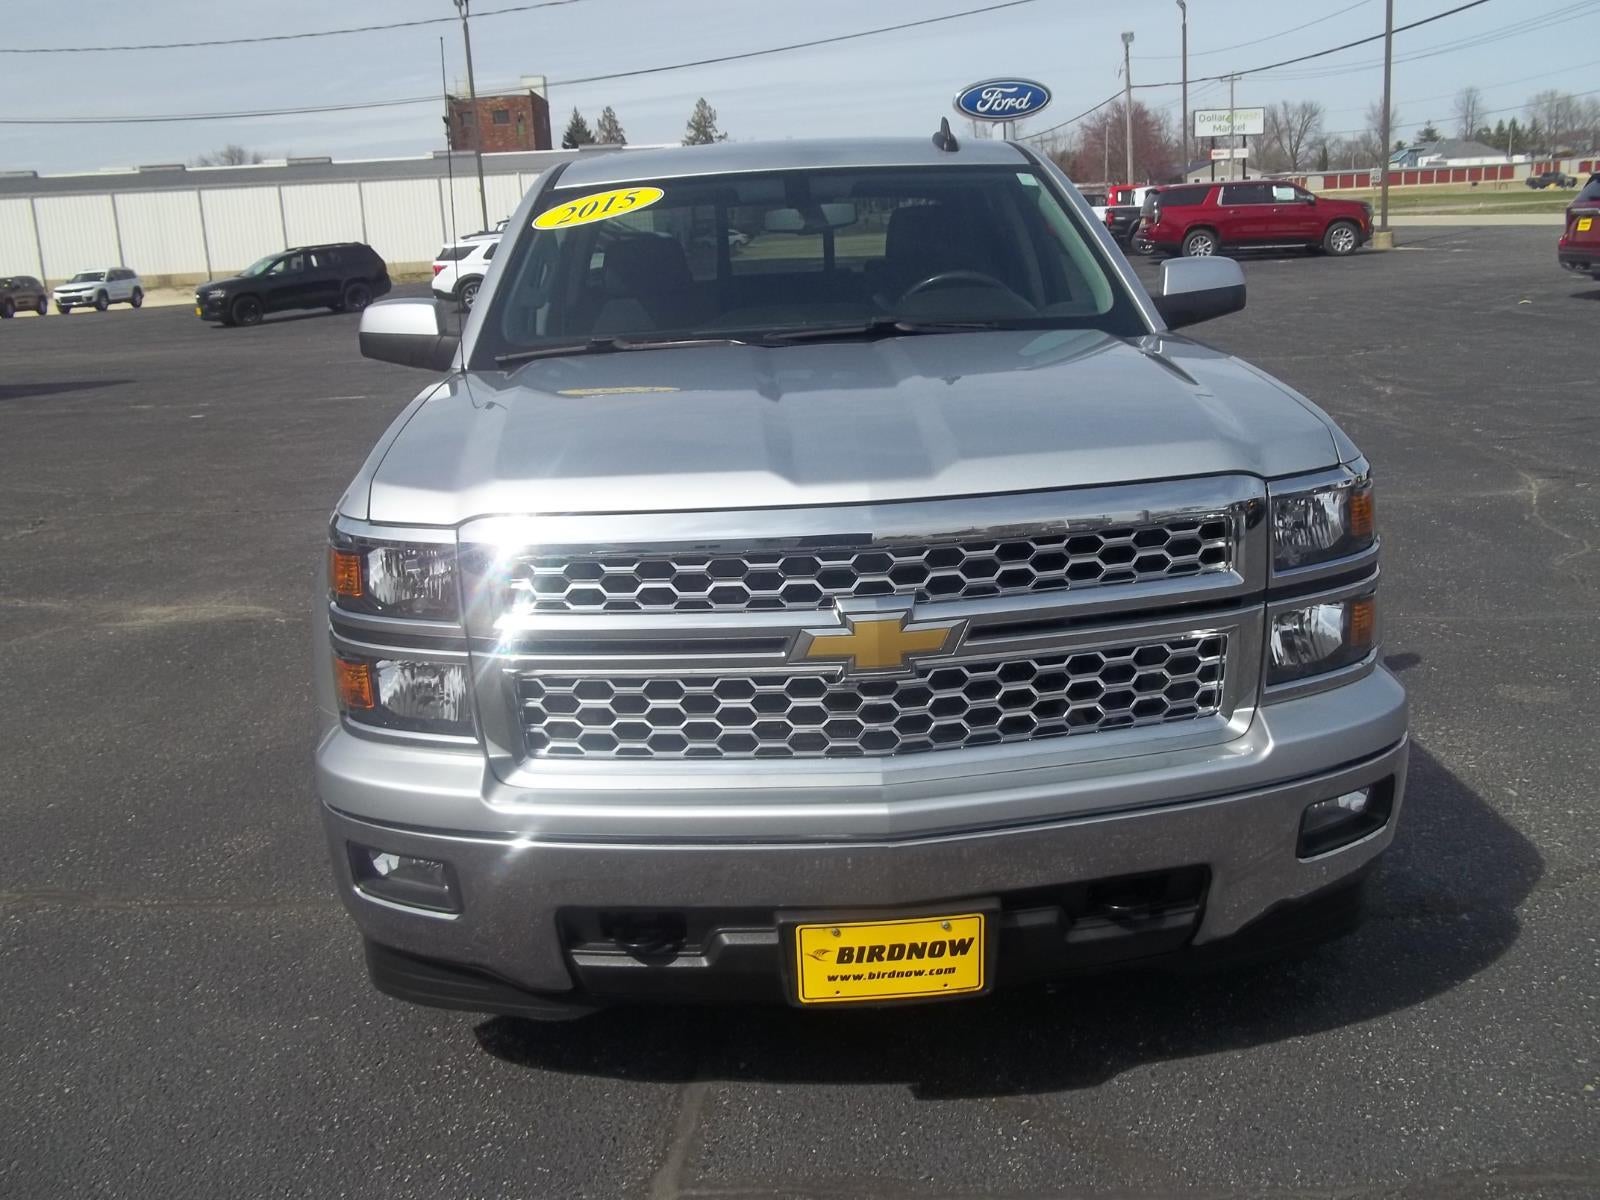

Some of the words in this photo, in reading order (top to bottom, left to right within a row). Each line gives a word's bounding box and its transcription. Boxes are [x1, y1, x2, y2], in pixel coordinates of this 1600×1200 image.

[976, 87, 1031, 112] Ford
[556, 191, 641, 225] 2015
[836, 937, 975, 964] BIRDNOW
[827, 967, 956, 982] www.birdnow.com
